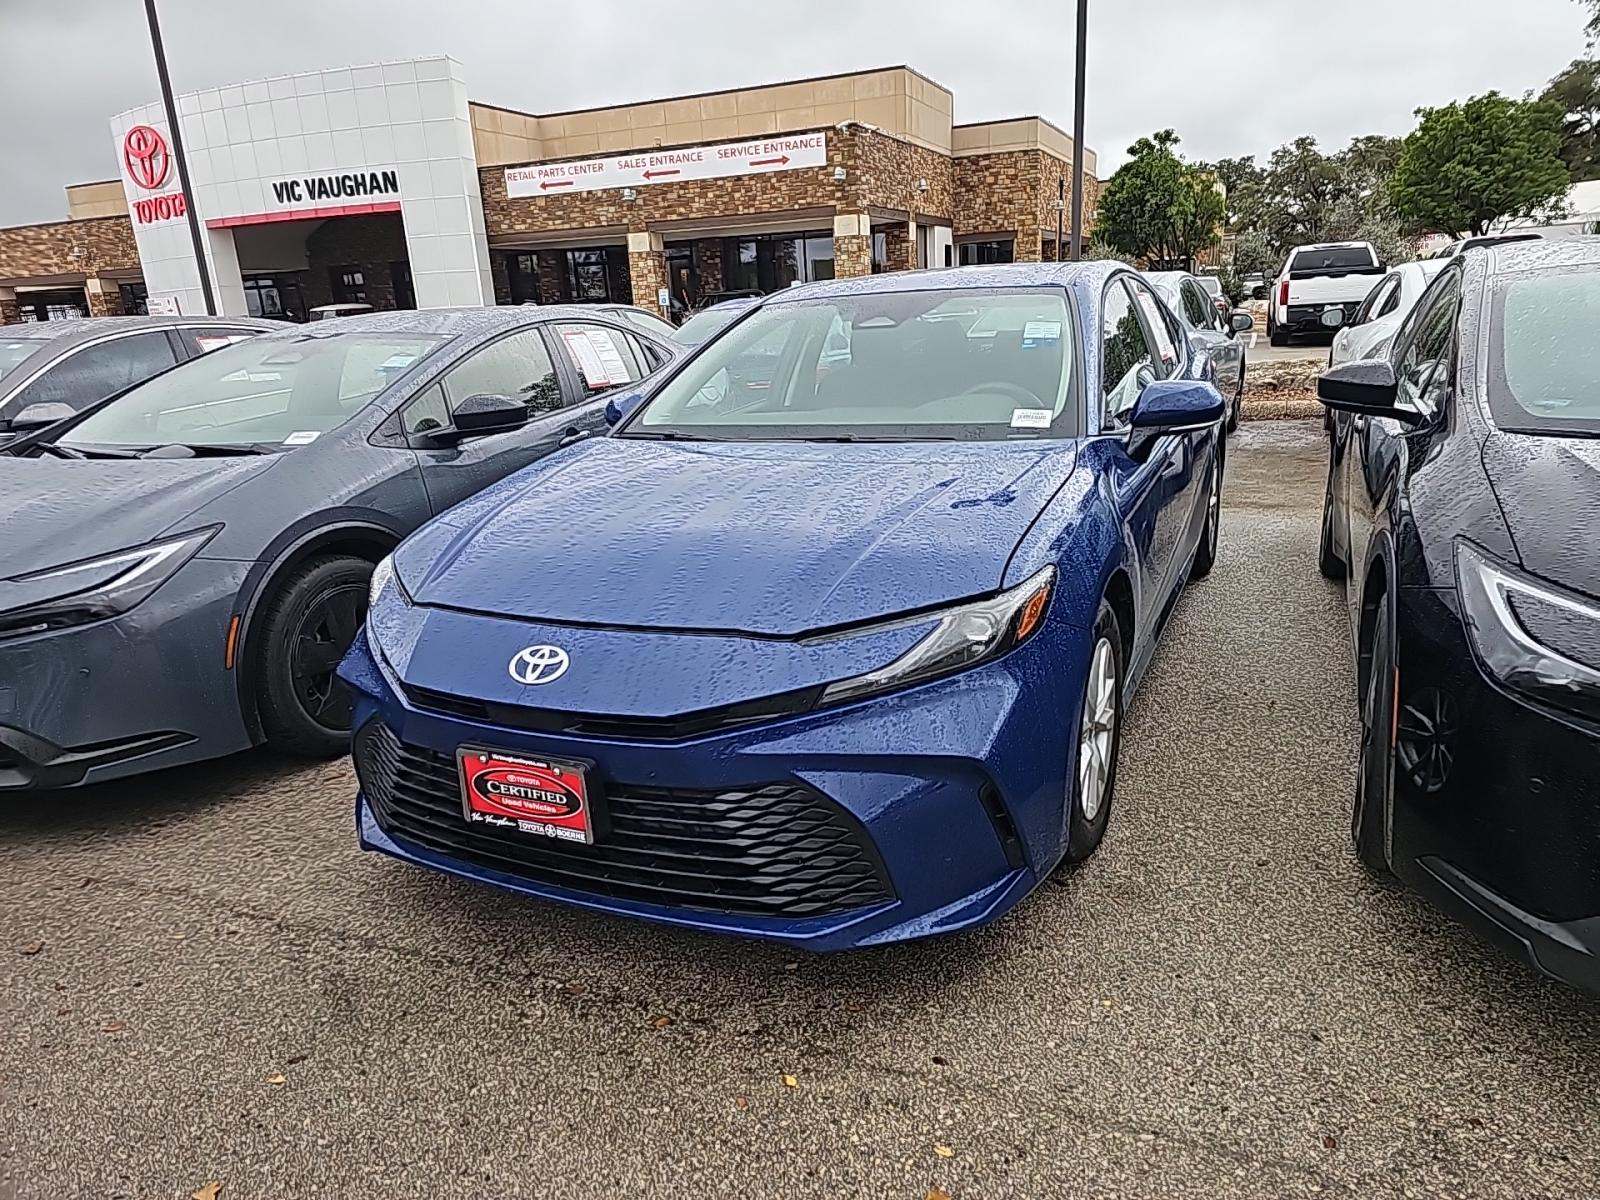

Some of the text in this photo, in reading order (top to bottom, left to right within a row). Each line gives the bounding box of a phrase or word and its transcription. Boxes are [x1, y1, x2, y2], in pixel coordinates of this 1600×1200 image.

[717, 137, 823, 159] SERVICE ENTRANCE
[617, 151, 703, 170] SALES ENTRANCE
[507, 163, 604, 182] RETAIL PARTS CENTER
[272, 170, 399, 203] VIC VAUGHAN
[133, 193, 187, 224] TOYOTA
[517, 777, 541, 786] TOYOTA
[486, 780, 567, 804] CERTIFIED
[501, 797, 557, 813] Used Vehicles
[518, 821, 545, 833] TOYOTA
[556, 829, 587, 841] BOERNE
